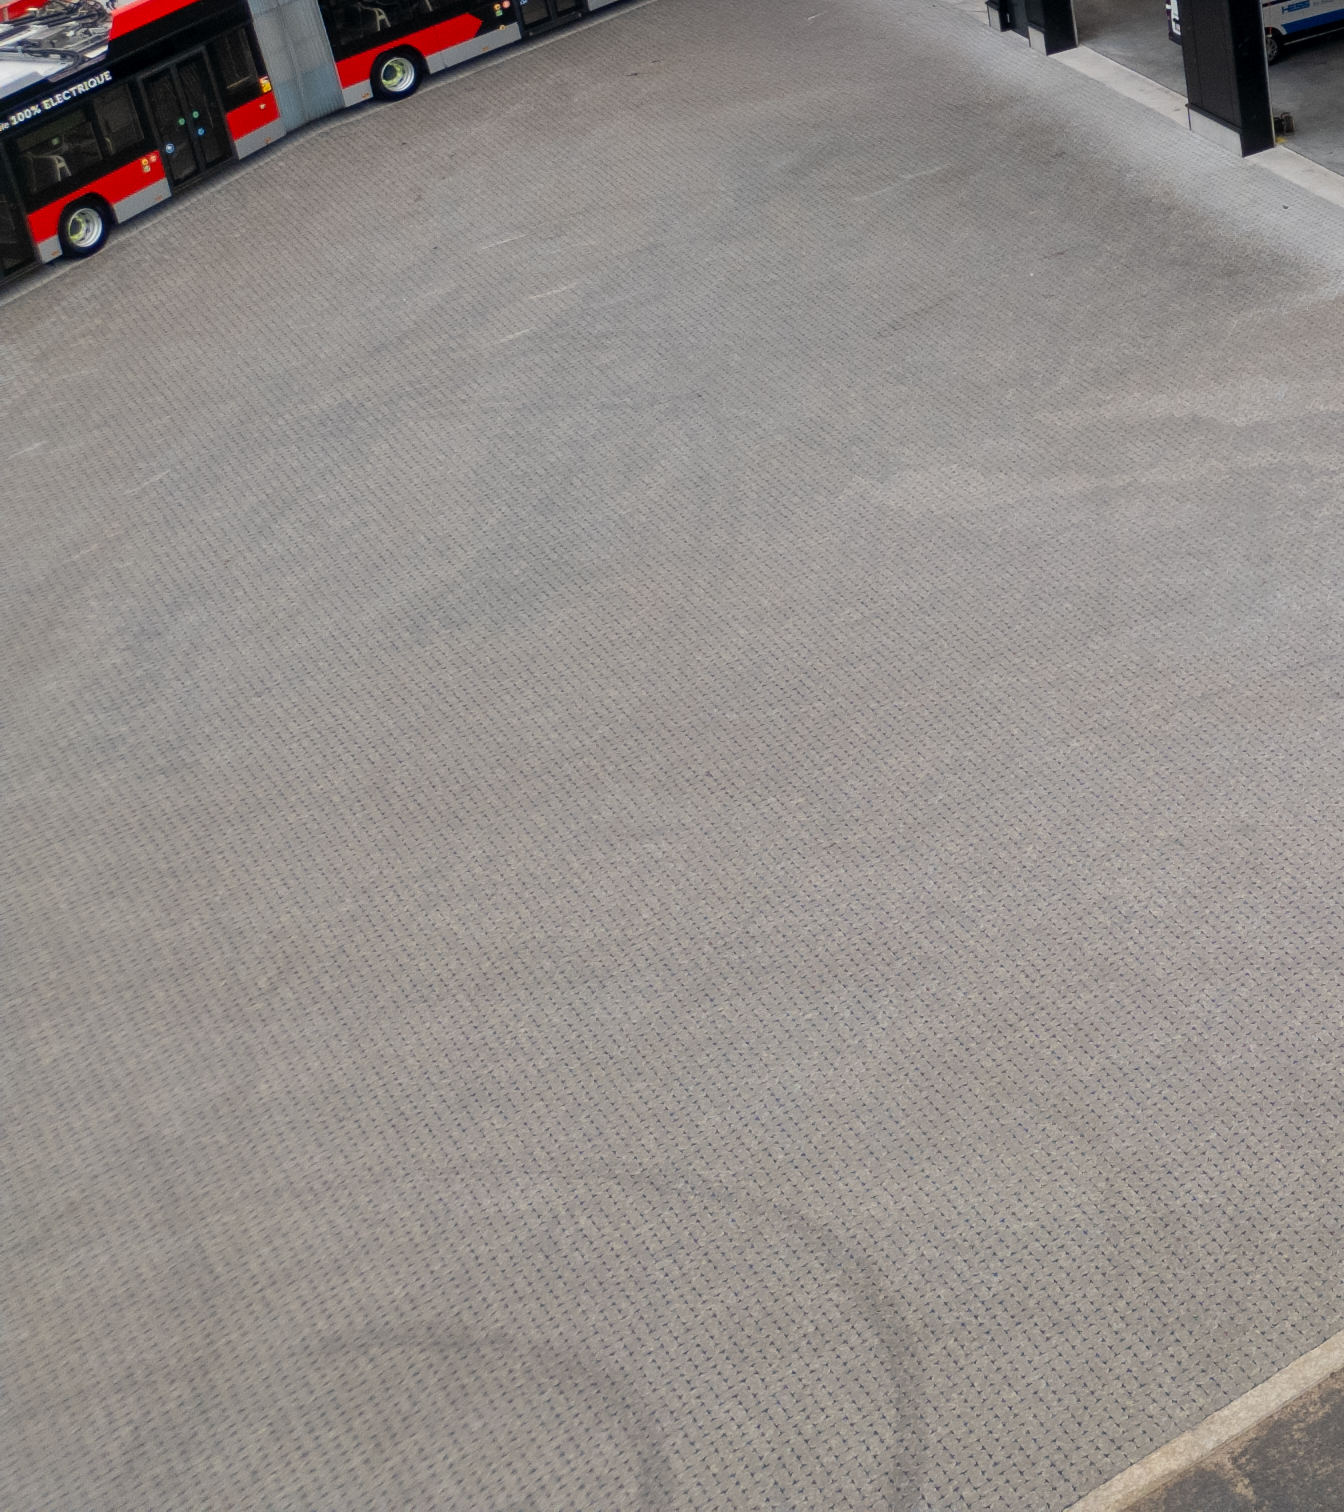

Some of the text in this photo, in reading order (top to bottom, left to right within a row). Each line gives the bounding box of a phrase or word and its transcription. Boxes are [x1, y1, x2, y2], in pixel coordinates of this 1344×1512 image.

[1281, 0, 1311, 14] HESS
[9, 103, 42, 126] 100%
[43, 70, 113, 110] ELECTRIQUE
